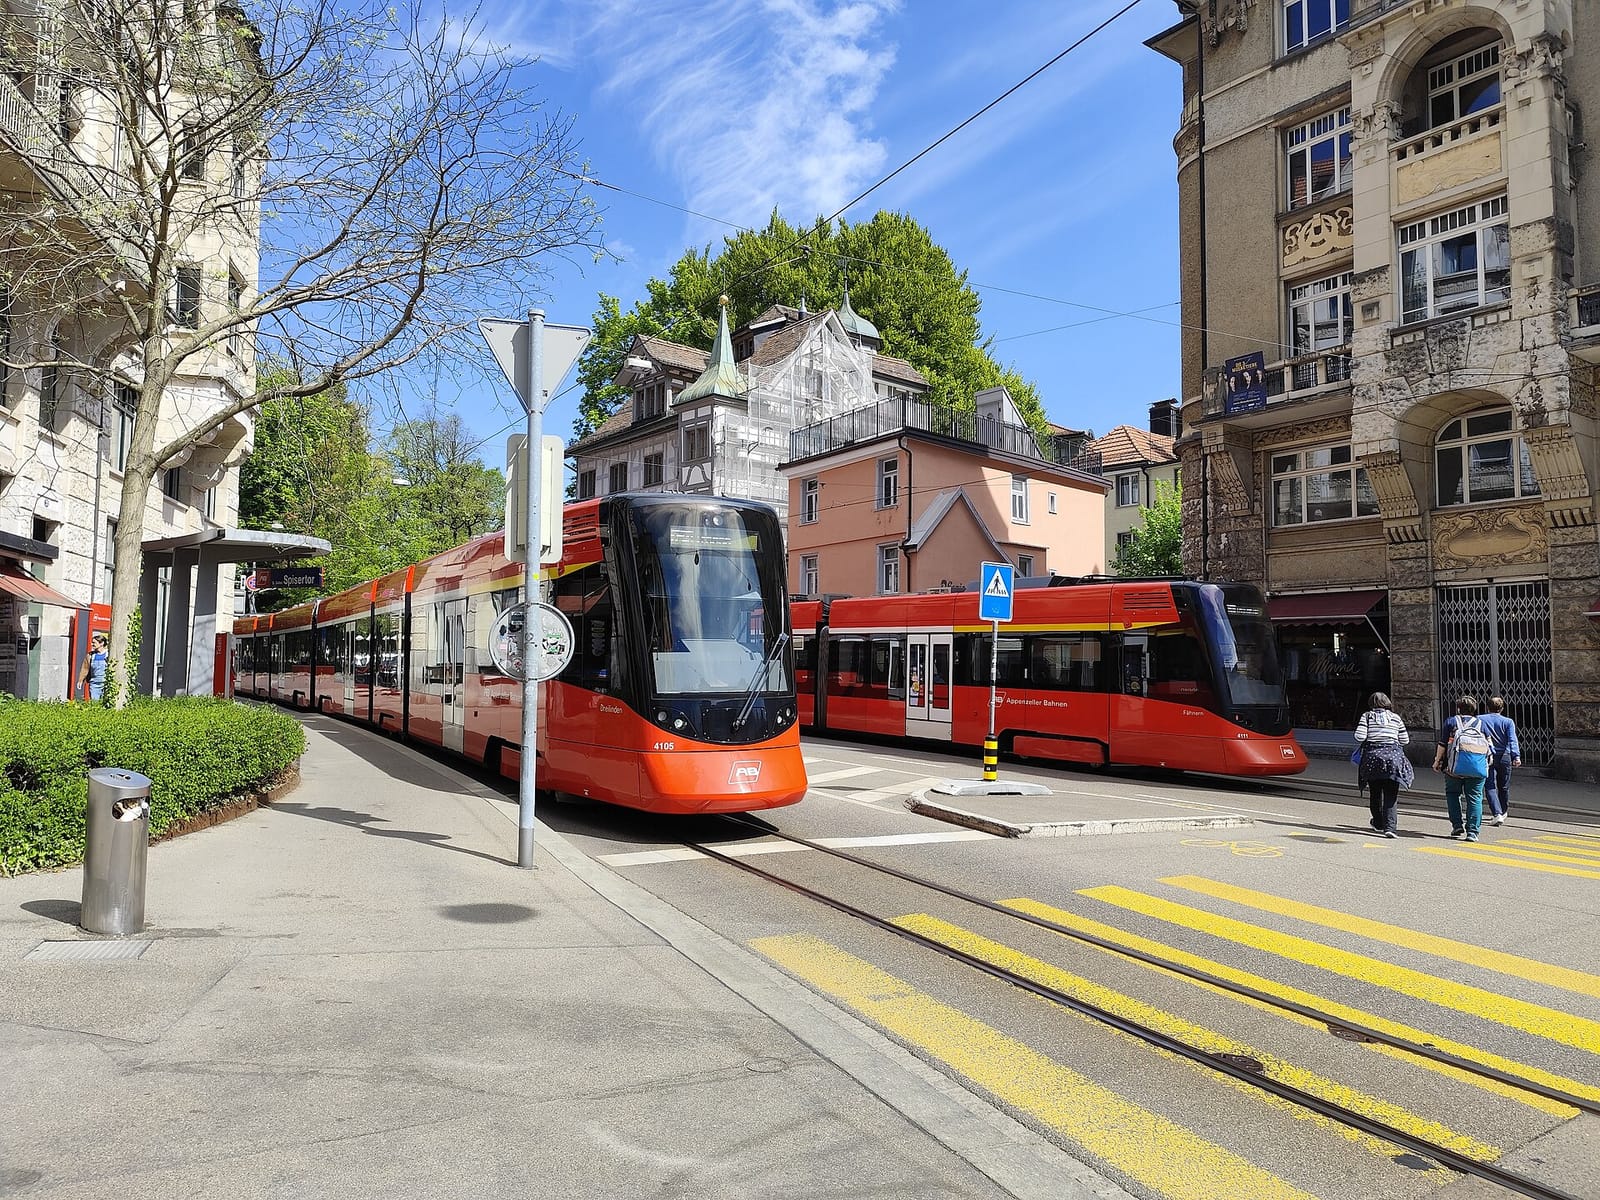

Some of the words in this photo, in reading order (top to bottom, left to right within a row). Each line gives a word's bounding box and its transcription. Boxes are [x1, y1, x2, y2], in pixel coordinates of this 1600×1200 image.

[283, 574, 314, 587] Spisertor
[1006, 697, 1042, 706] Appenzeller
[1043, 699, 1068, 708] Bahnen
[653, 742, 675, 750] 4105
[735, 766, 761, 777] AB
